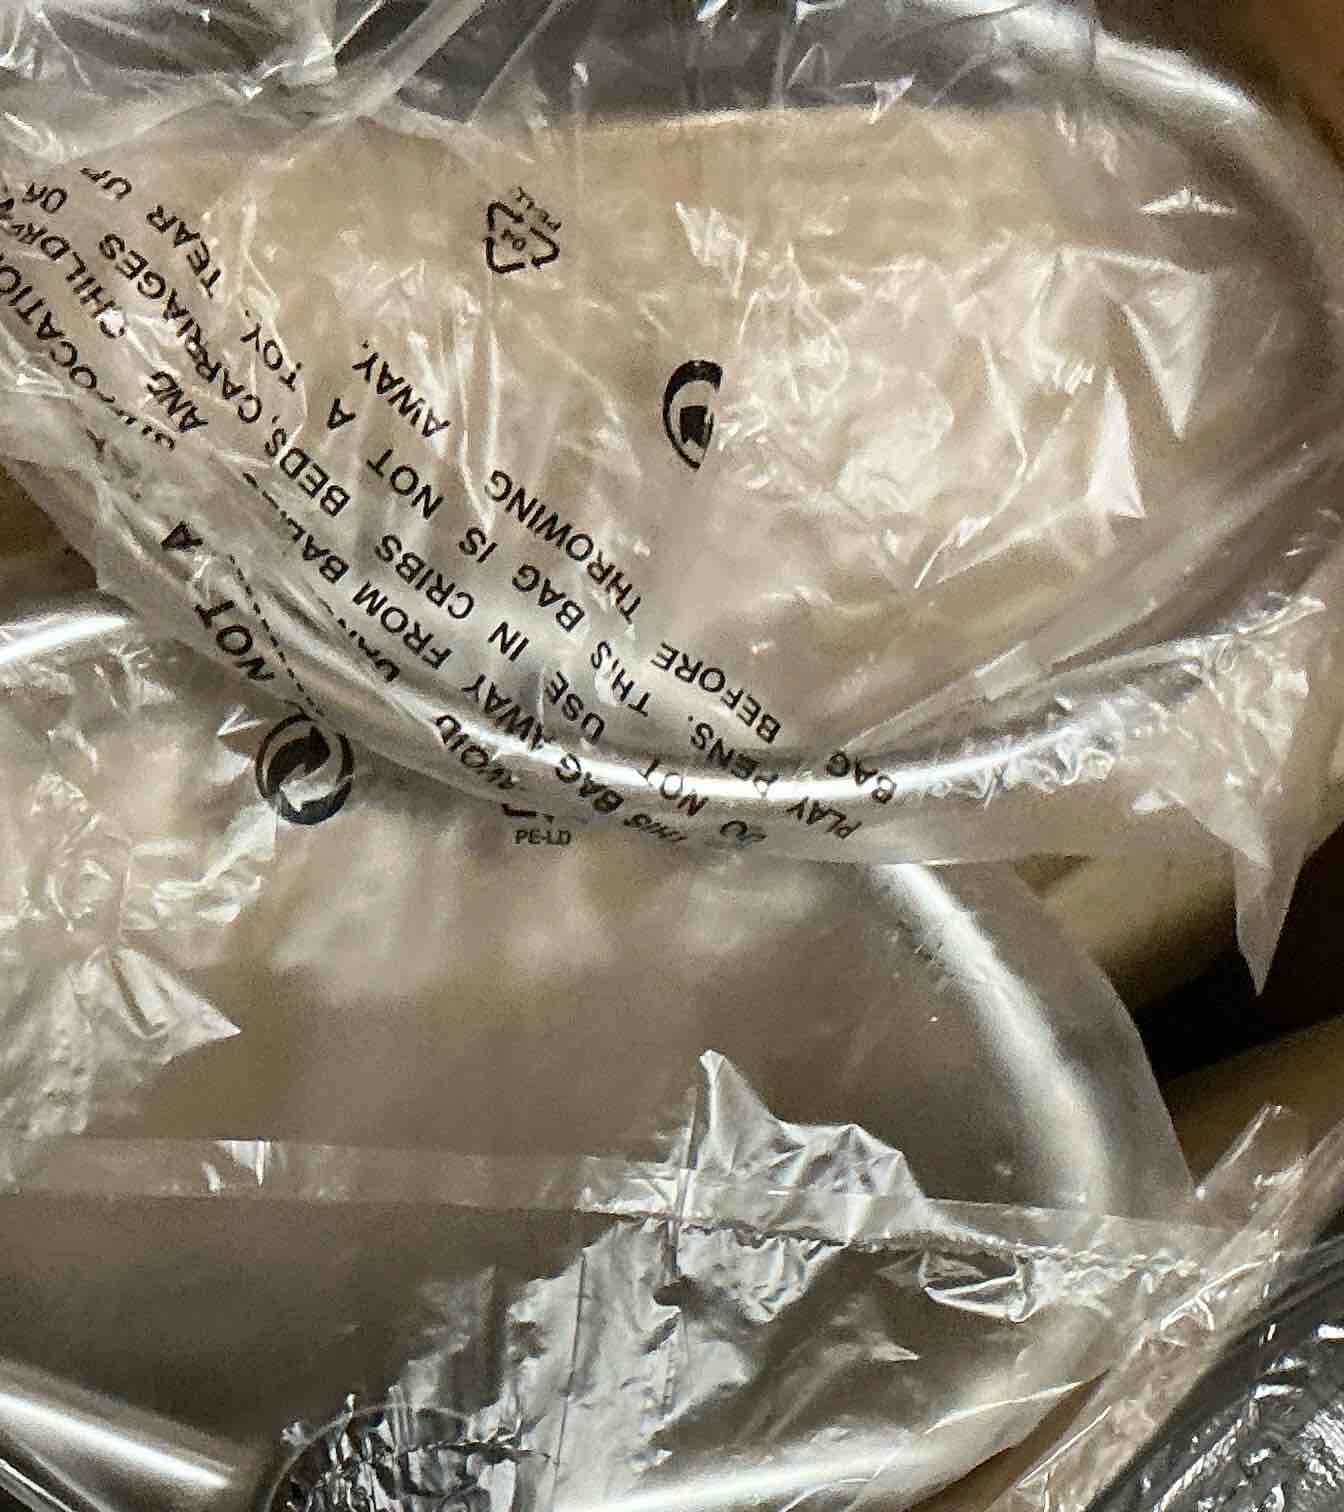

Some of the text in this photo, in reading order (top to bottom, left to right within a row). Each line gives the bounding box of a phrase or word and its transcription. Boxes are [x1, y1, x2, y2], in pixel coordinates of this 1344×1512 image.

[145, 204, 222, 299] TEAR
[97, 232, 263, 424] CARRIAGES
[239, 309, 303, 393] TOY.
[326, 397, 357, 430] A
[264, 415, 351, 518] BEDS,
[366, 448, 445, 521] NOT
[351, 339, 897, 806] BAG BEFORE THROWING AWAY.
[374, 534, 475, 620] CRIBS
[458, 526, 498, 564] IS
[160, 520, 276, 681] NOT A
[351, 580, 453, 670] FROM
[511, 563, 585, 633] BAG
[487, 621, 530, 663] IN
[590, 640, 652, 718] THIS
[461, 673, 556, 751] AWAY
[544, 670, 606, 745] USE
[554, 753, 625, 815] BAG
[635, 757, 709, 818] NOT
[687, 714, 779, 800] PENS.
[785, 796, 863, 840] PLAY
